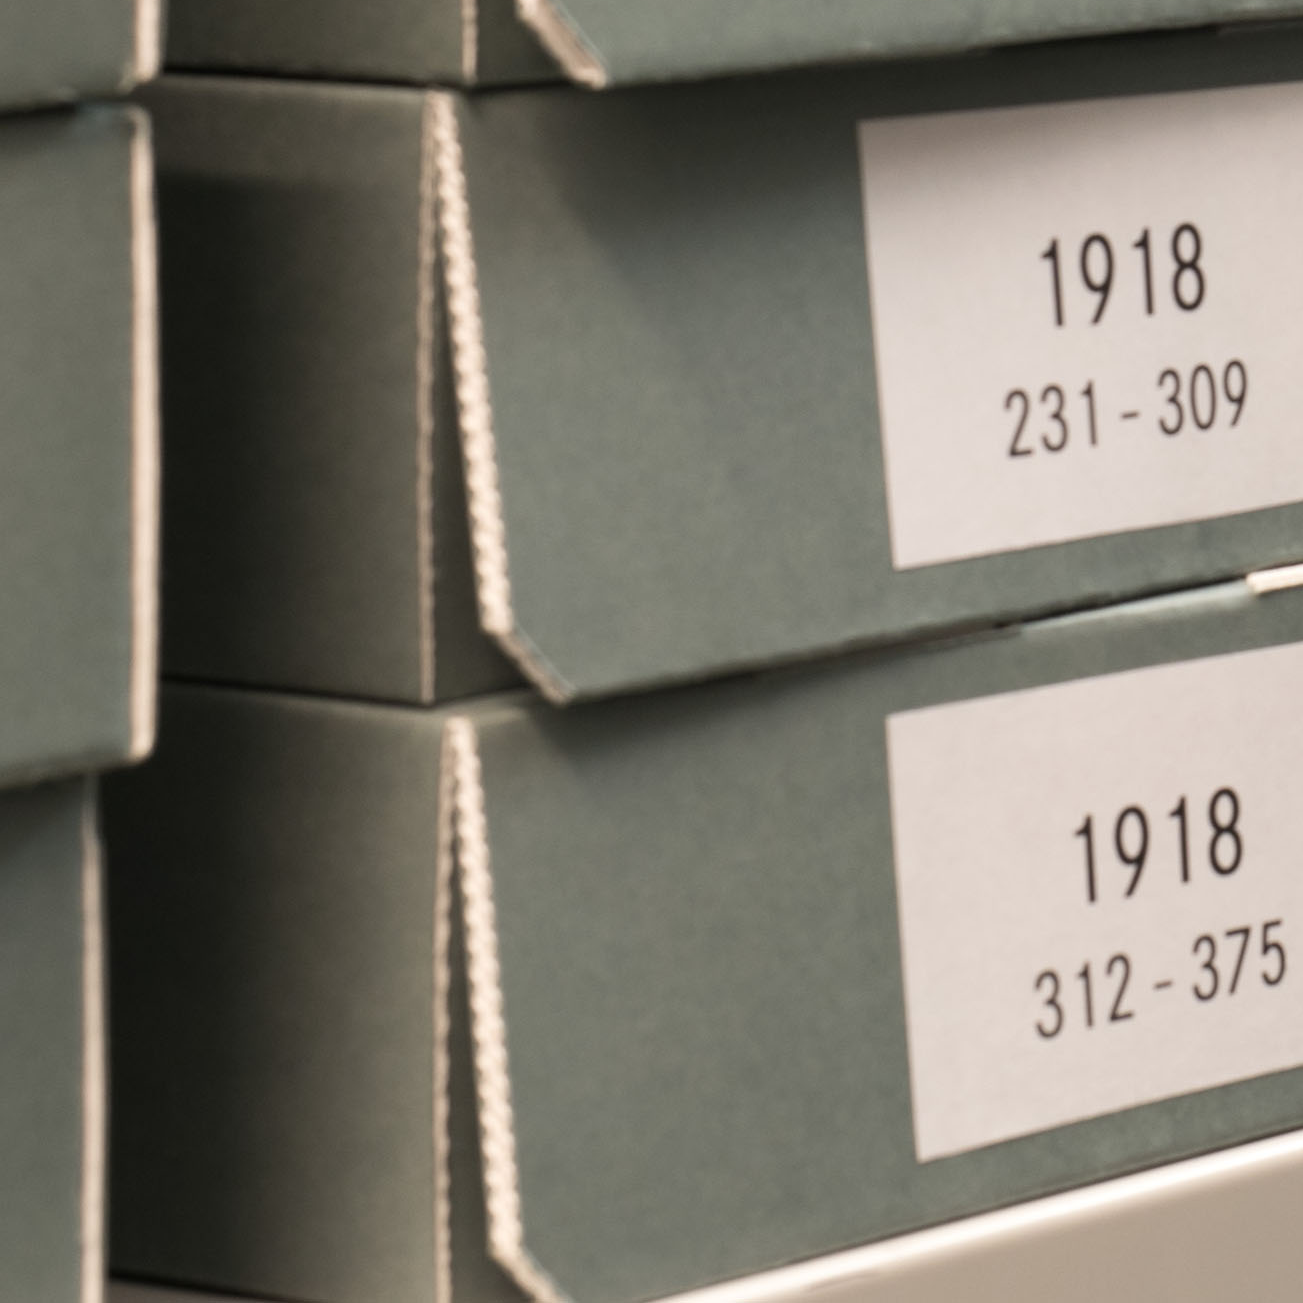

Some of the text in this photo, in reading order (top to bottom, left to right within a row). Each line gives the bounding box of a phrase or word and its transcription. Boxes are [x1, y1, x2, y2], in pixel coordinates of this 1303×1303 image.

[1042, 223, 1205, 326] 1918
[1005, 359, 1248, 458] 231-309
[1076, 788, 1243, 902] 1918
[1035, 919, 1286, 1039] 312-375
